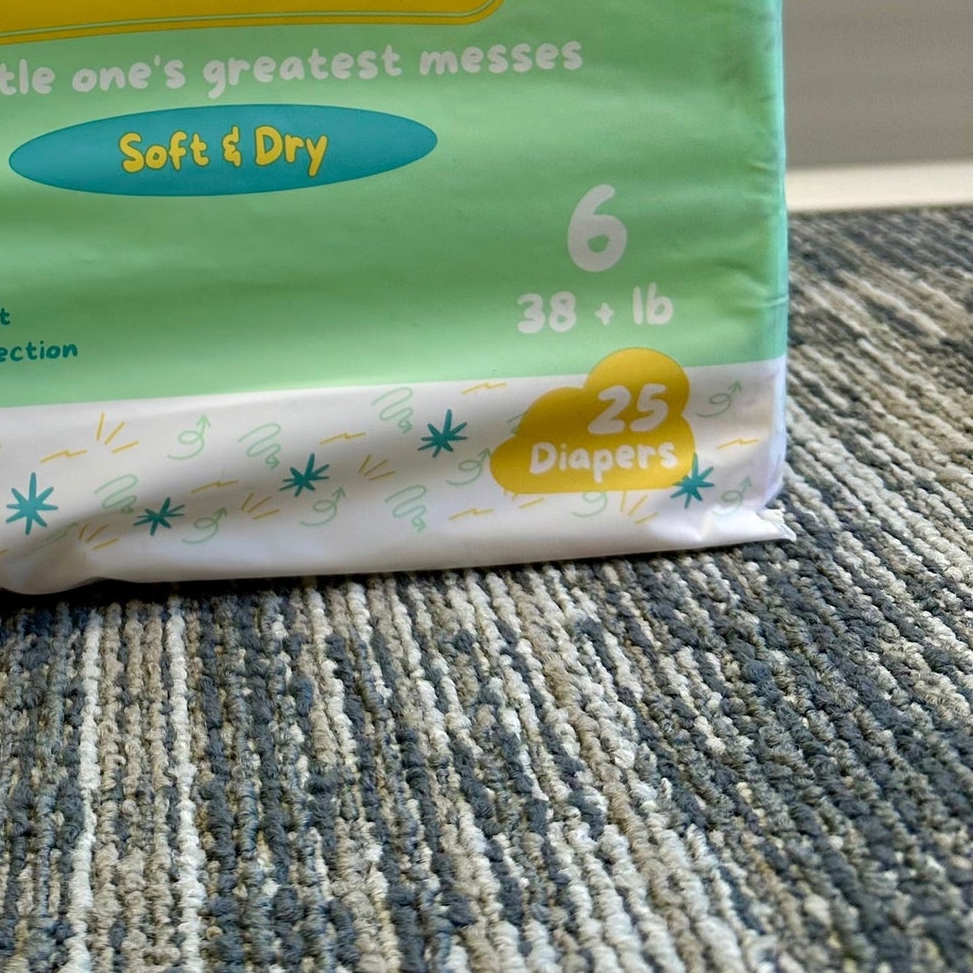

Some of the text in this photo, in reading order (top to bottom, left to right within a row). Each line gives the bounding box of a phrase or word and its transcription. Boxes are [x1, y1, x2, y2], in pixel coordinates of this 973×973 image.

[72, 55, 185, 93] one's
[203, 45, 402, 98] greatest
[419, 41, 584, 76] messes
[119, 125, 328, 177] Soft & Dry
[567, 184, 627, 272] 6
[517, 282, 673, 334] 38 + lb
[587, 383, 669, 435] 25
[529, 441, 678, 483] Diapers
